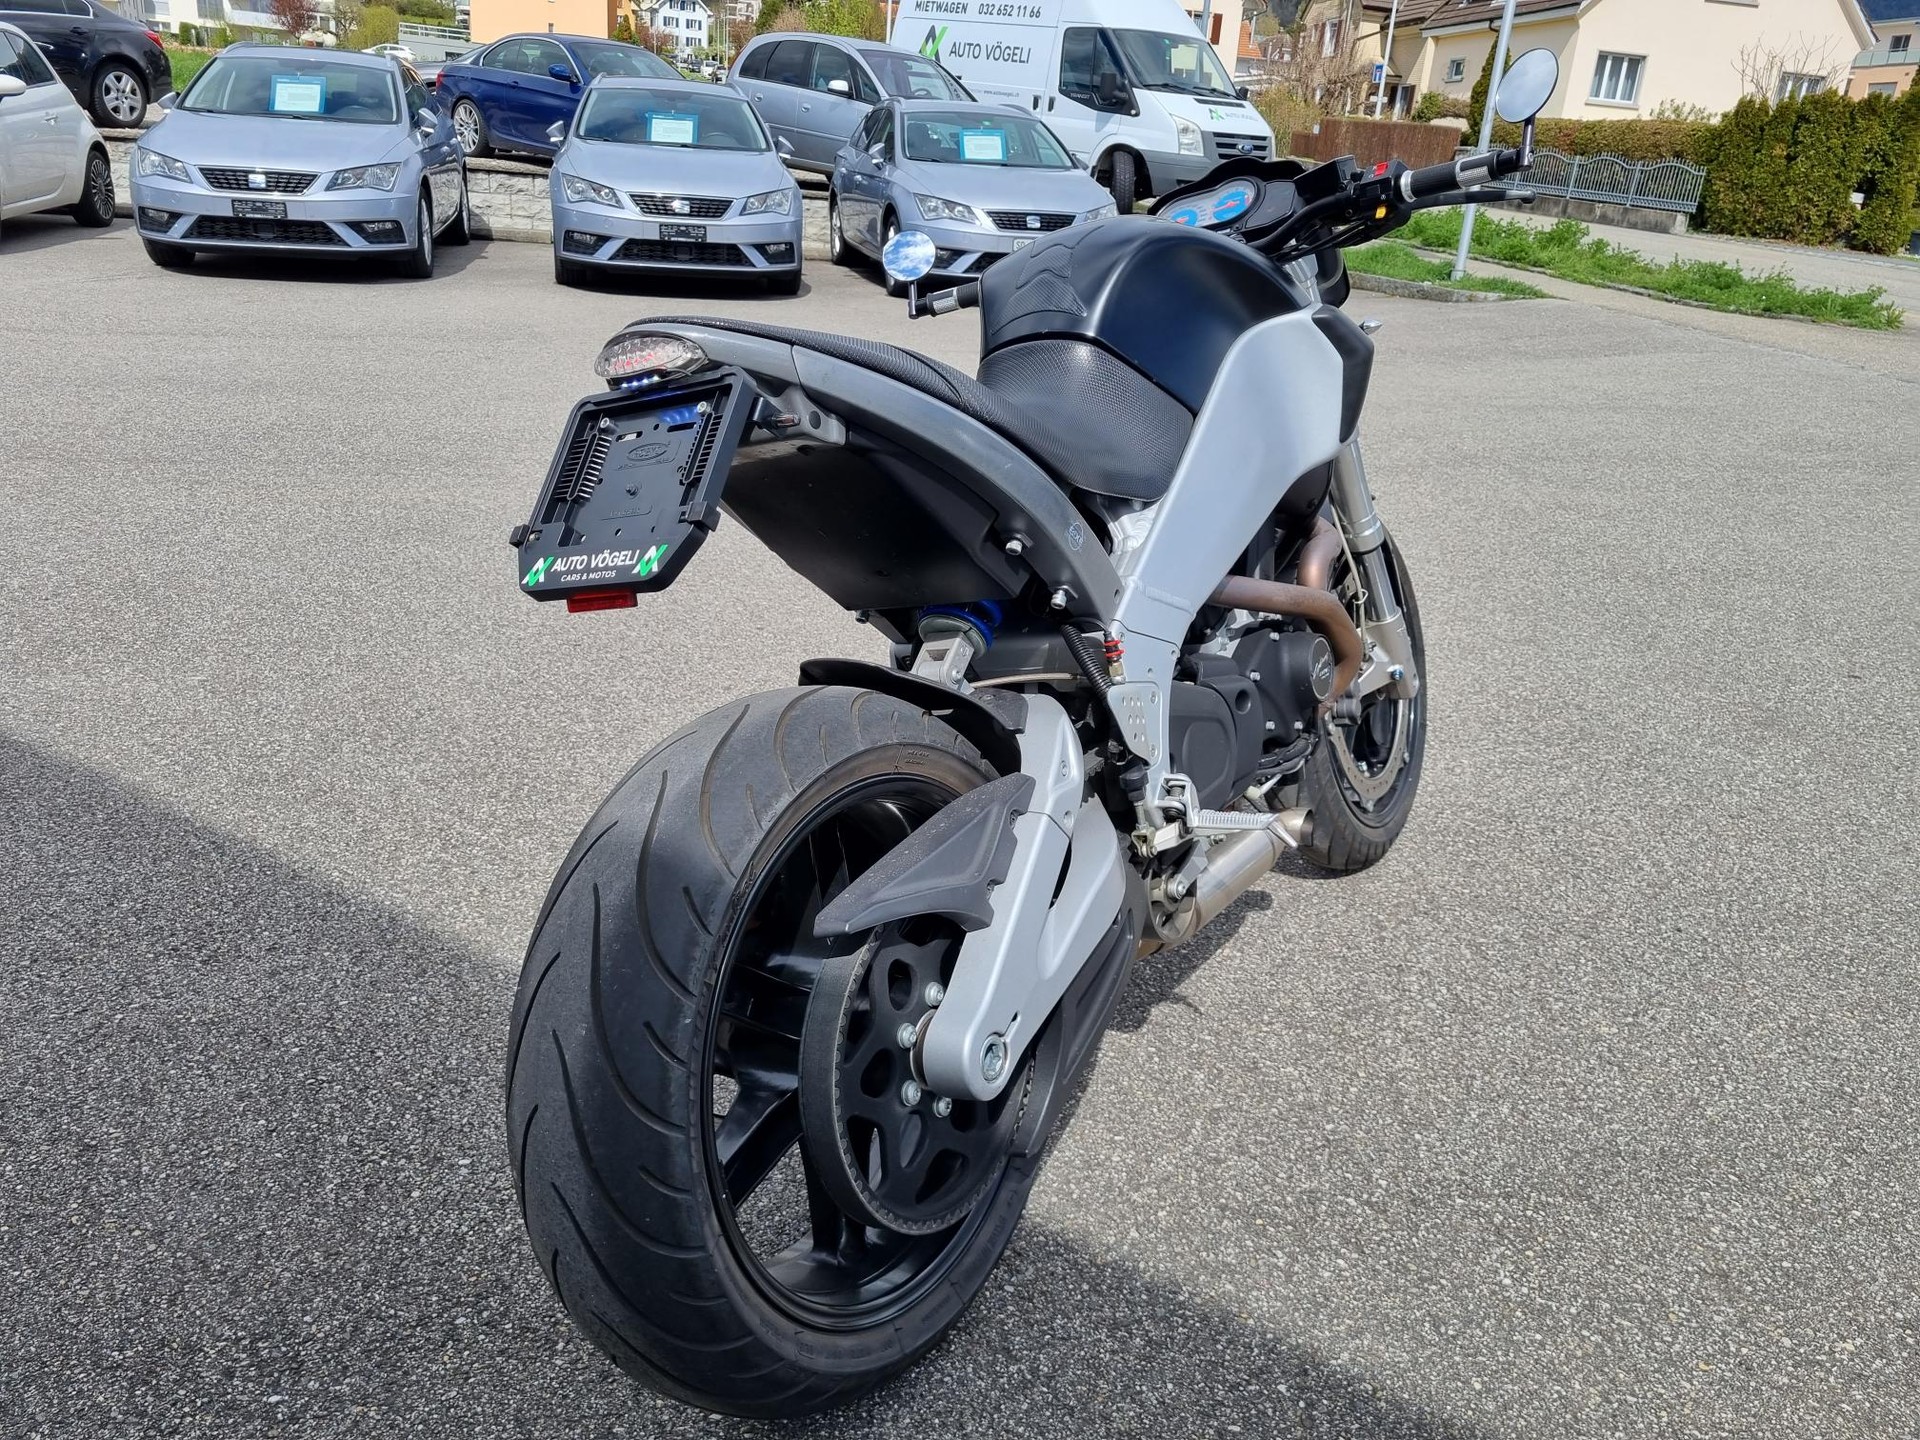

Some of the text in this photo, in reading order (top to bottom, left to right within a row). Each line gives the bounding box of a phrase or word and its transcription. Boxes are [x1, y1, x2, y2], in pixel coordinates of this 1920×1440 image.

[915, 1, 1041, 18] MIETWAGEN 032 652 11 66
[949, 41, 1031, 64] AUTO VÖGELI
[551, 549, 640, 572] AUTO VÖGELI
[561, 573, 581, 582] CARS
[588, 570, 616, 579] MOTOS
